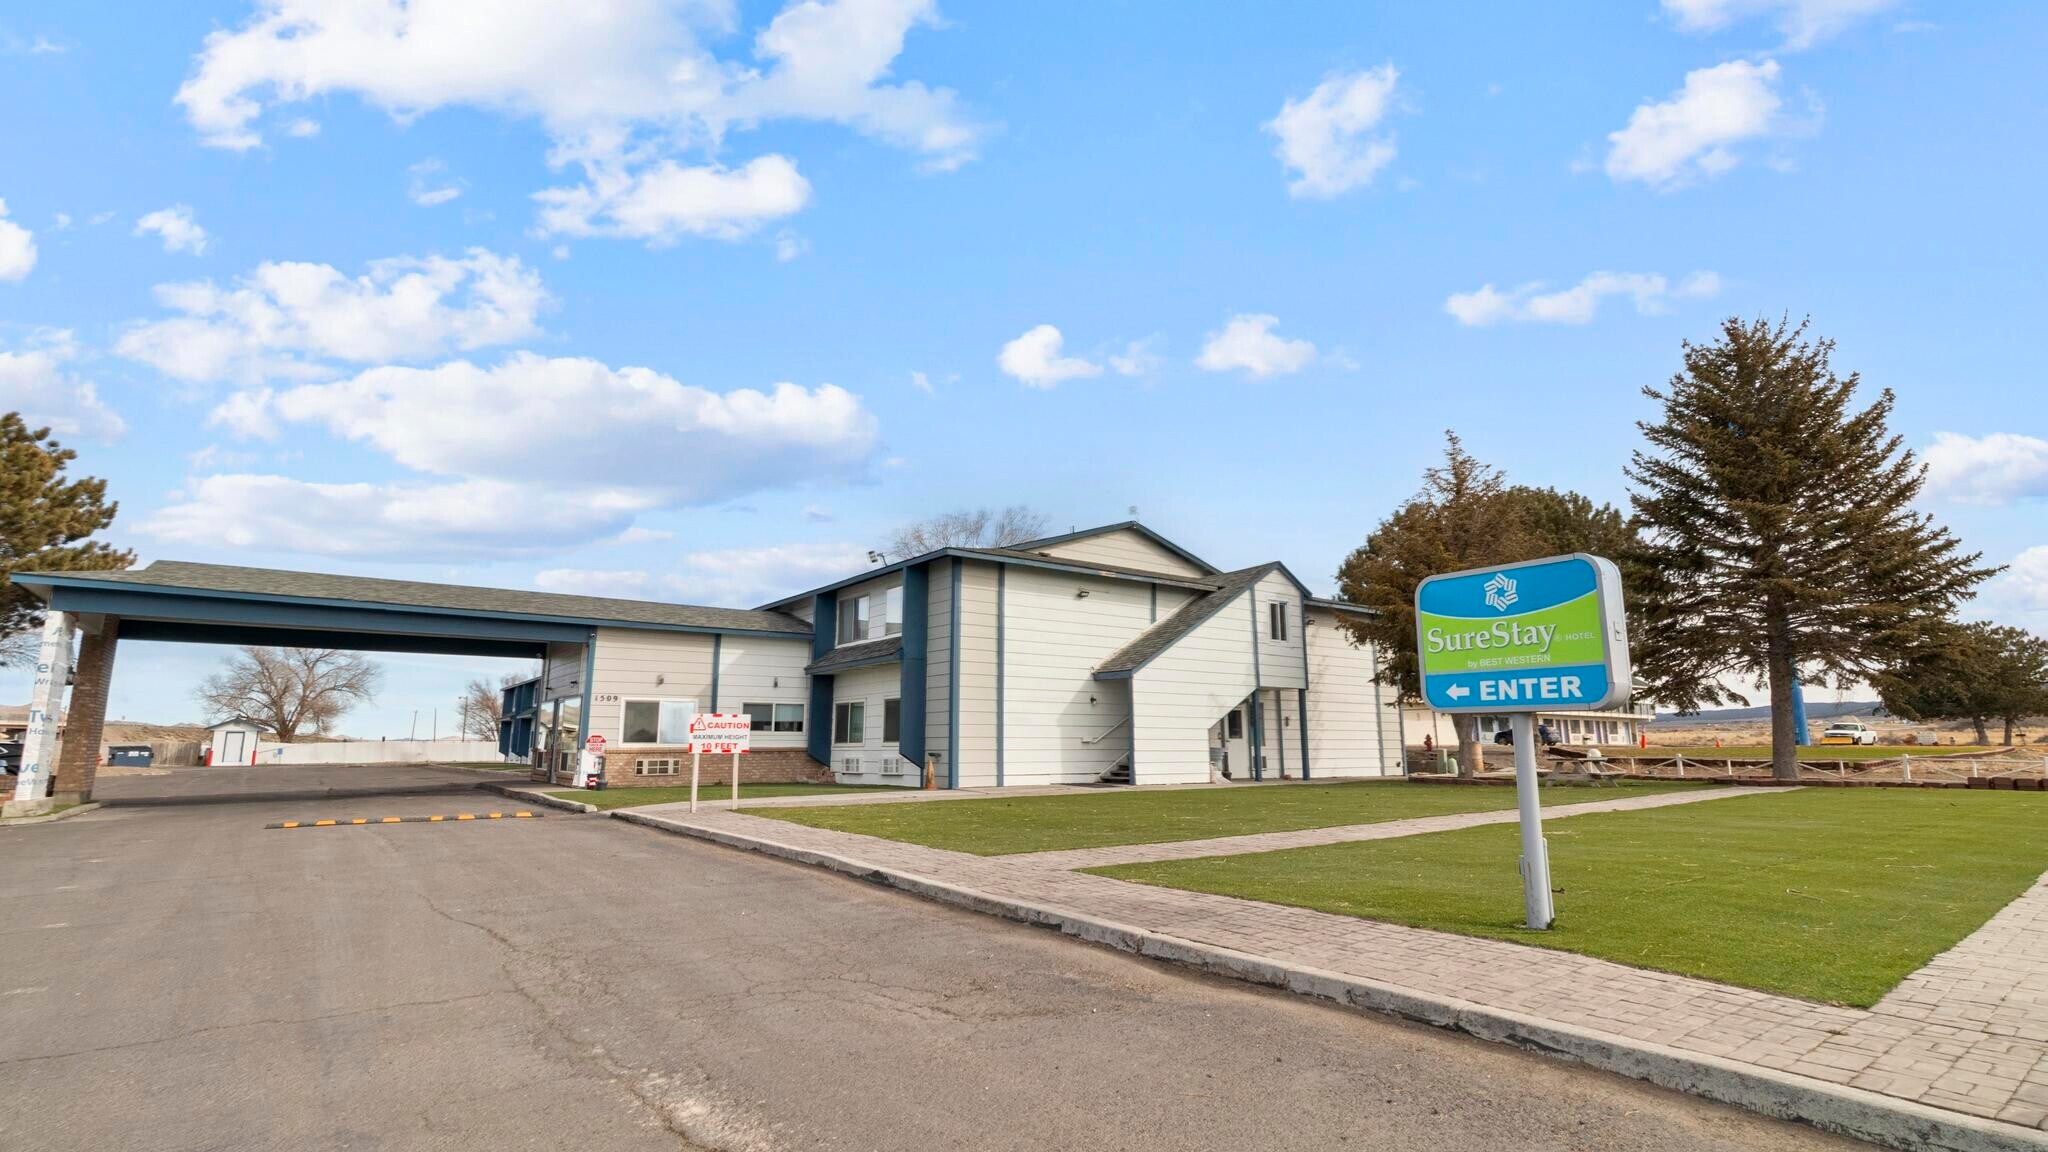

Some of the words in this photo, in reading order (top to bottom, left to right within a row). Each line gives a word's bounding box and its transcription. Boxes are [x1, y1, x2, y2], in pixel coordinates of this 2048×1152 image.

[1565, 632, 1595, 641] HOTEL
[1467, 660, 1478, 668] by
[1480, 657, 1502, 666] BEST
[1504, 654, 1551, 665] WESTERN
[1479, 676, 1583, 701] ENTER
[595, 695, 618, 703] 1509
[714, 742, 738, 750] FEET
